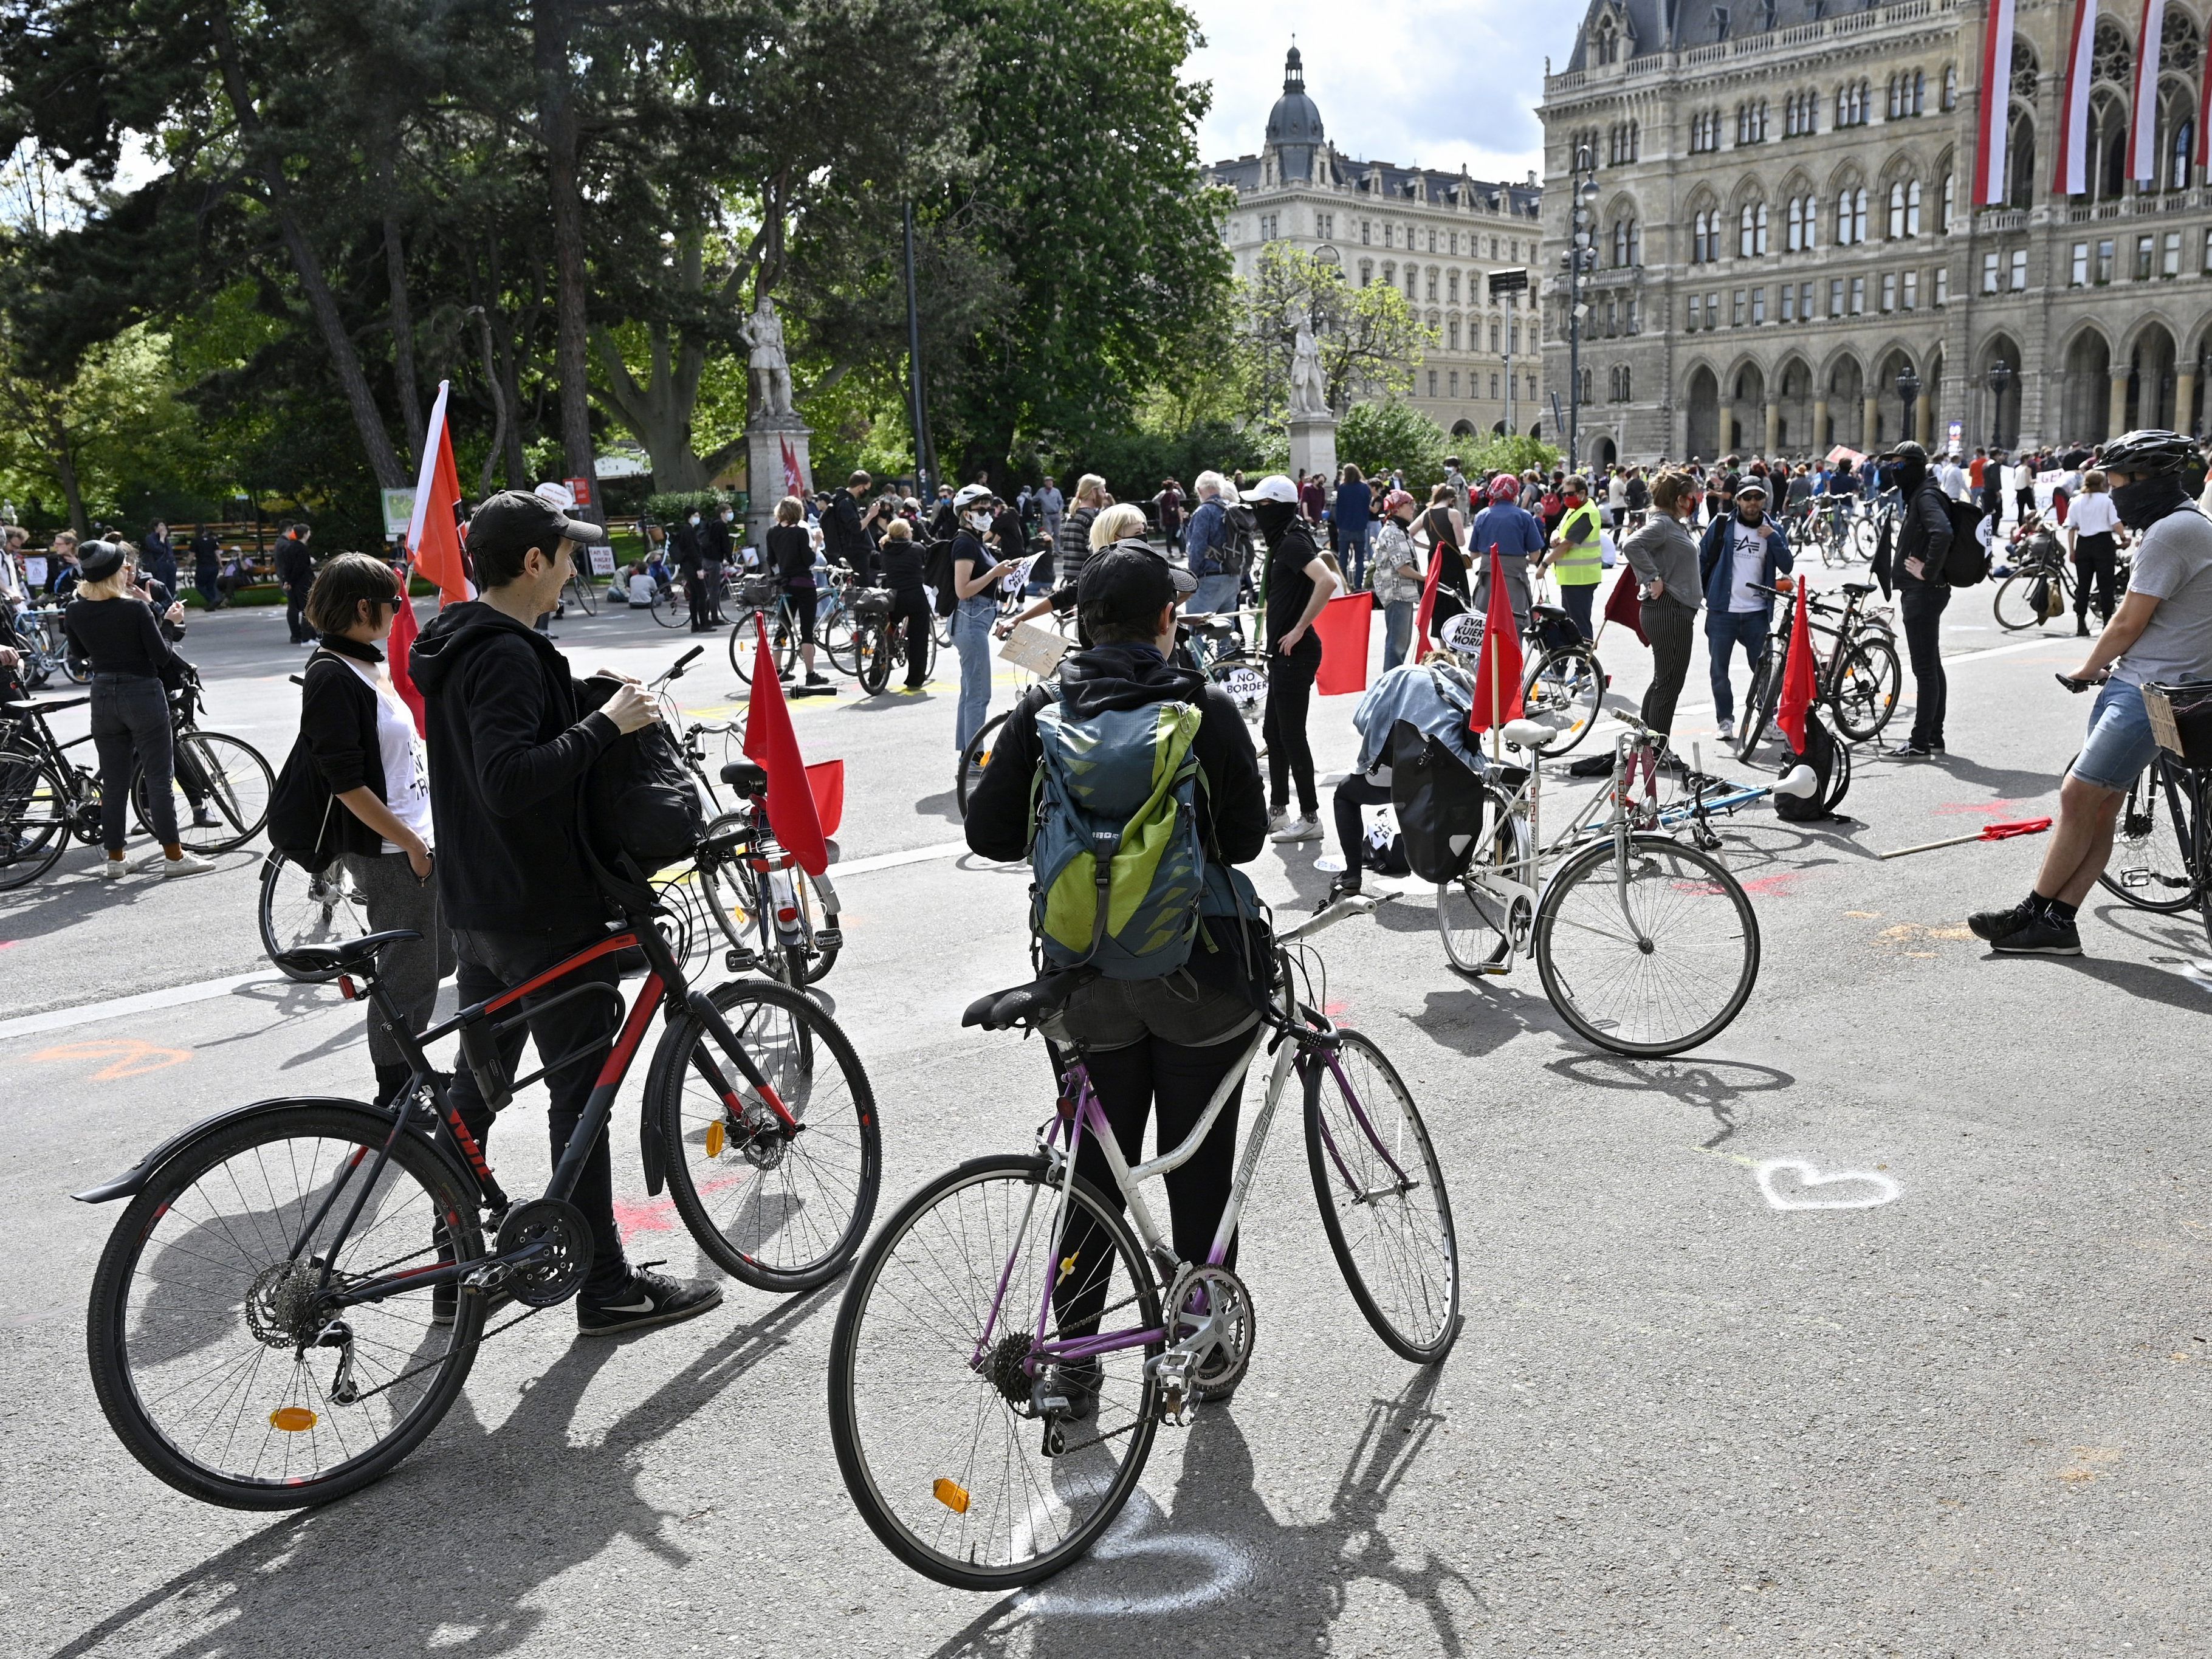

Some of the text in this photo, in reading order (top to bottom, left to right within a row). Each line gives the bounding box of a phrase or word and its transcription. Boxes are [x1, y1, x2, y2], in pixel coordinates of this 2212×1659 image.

[1009, 570, 1021, 585] NO
[1237, 673, 1255, 682] NO
[1233, 1101, 1275, 1207] SURSEE
